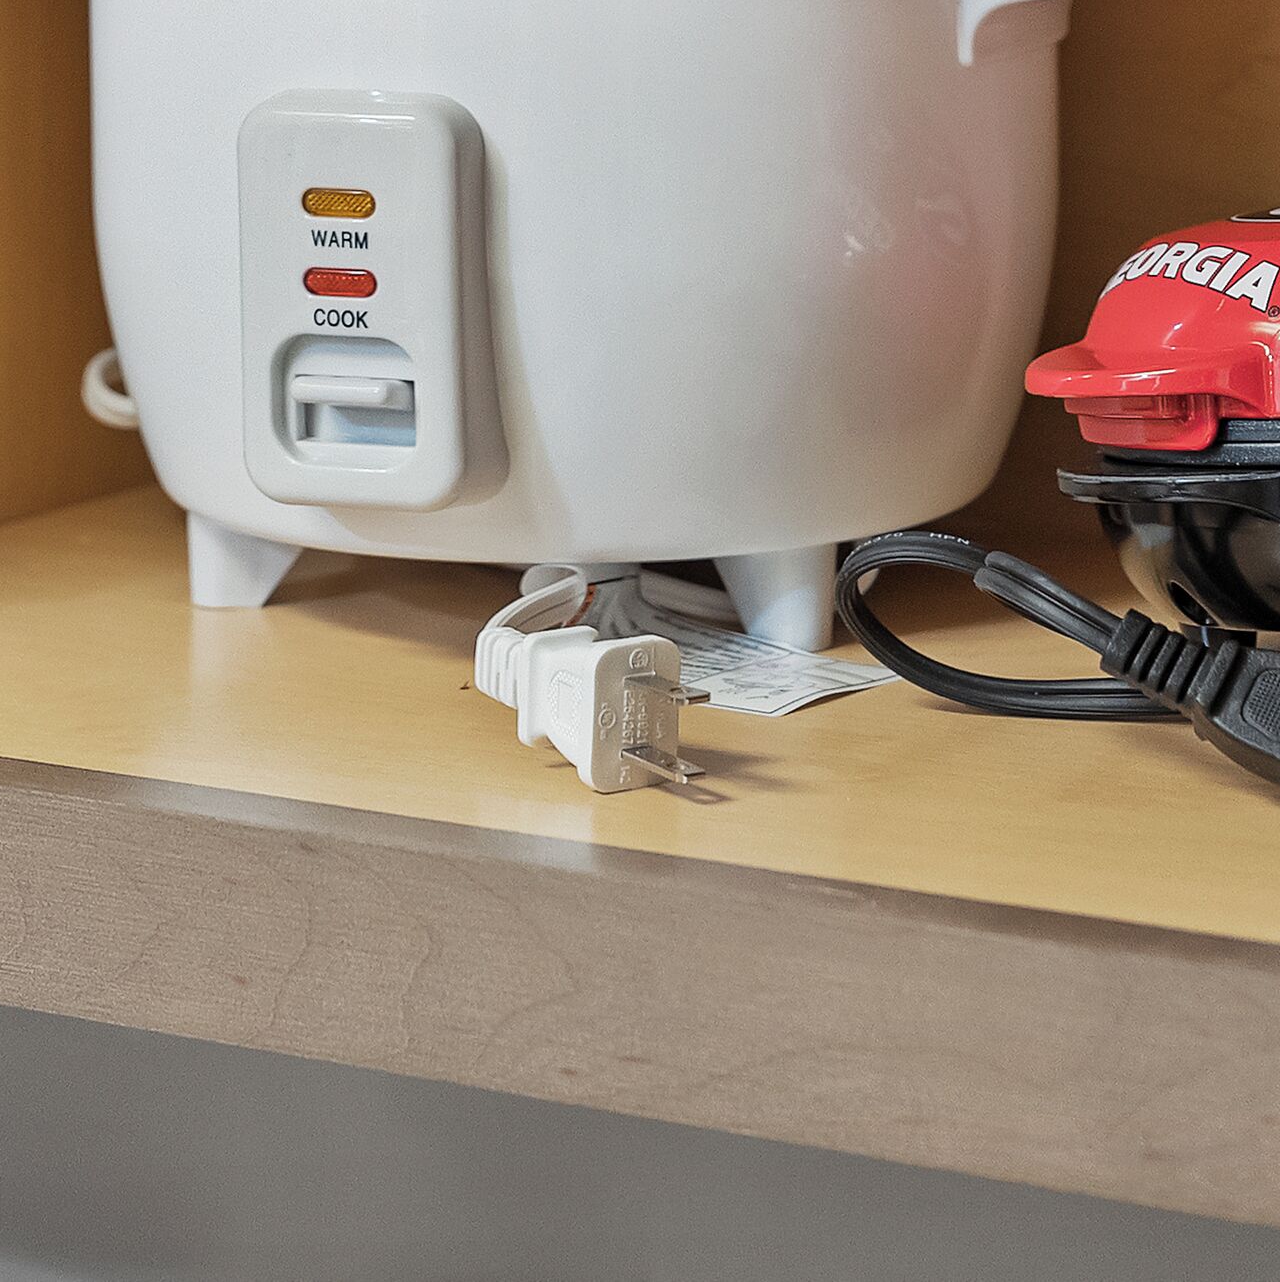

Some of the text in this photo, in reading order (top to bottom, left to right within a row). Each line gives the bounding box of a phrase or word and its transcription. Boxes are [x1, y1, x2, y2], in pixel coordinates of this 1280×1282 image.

[311, 229, 369, 249] WARM
[1099, 242, 1280, 312] EORGIA
[313, 308, 369, 329] COOK
